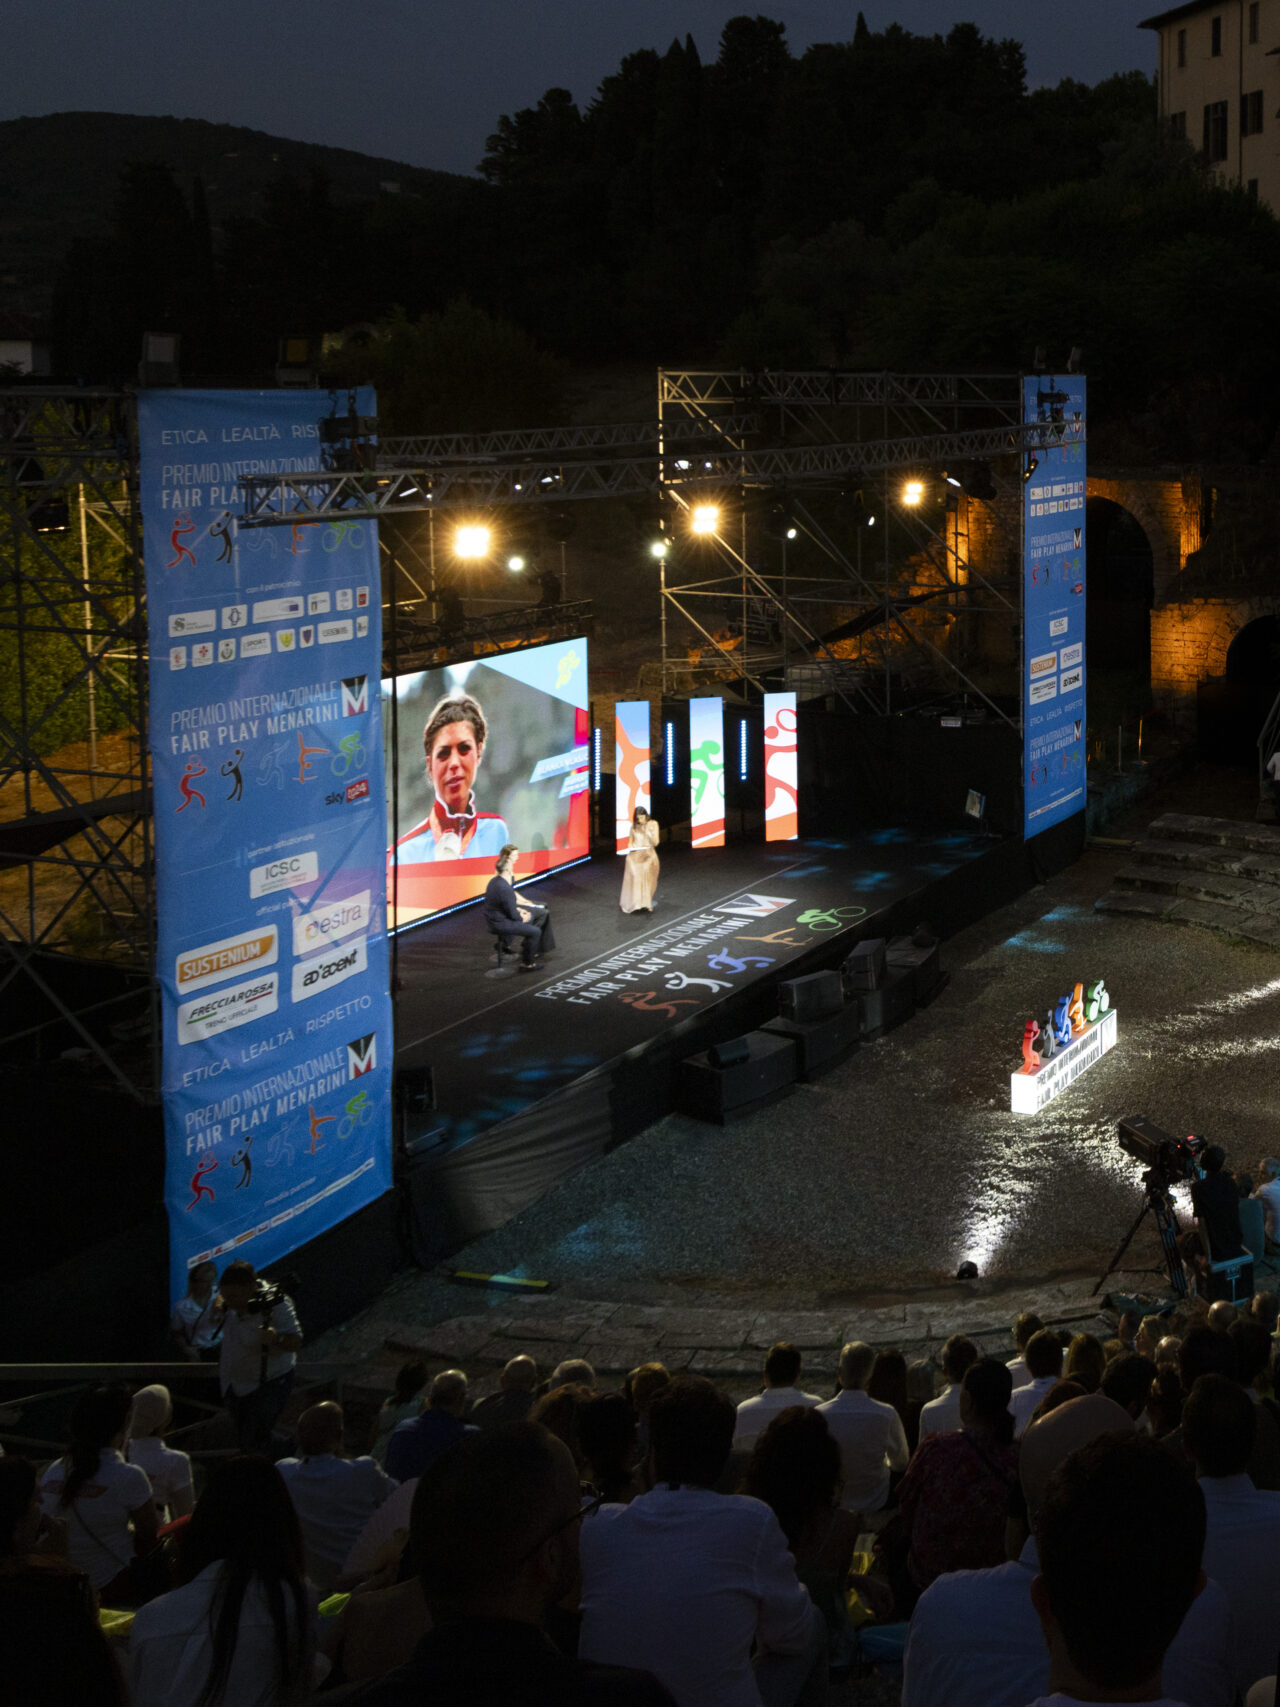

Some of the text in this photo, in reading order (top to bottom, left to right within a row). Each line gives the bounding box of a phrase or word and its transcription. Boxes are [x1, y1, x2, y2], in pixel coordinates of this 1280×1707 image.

[161, 429, 208, 445] ETICA
[222, 424, 281, 443] LEALTÀ
[161, 462, 220, 486] PREMIO
[161, 488, 202, 509] FAIR
[170, 680, 338, 733] PREMIO INTERNAZIONALE
[171, 703, 339, 755] FAIR PLAY MENARINI
[265, 858, 300, 880] ICSC
[320, 904, 361, 934] estra
[183, 940, 261, 981] SUSTENIUM
[534, 912, 725, 1000] PREMIO INTERNAZIONALE
[566, 917, 755, 1005] FAIR PLAY MENARINI
[189, 981, 274, 1019] FRECCIAROSSA
[182, 995, 372, 1088] ETICA LEALTÀ RISPETTO
[184, 1046, 345, 1135] PREMIO INTERNAZIONALE
[1053, 1071, 1069, 1096] PLAY
[186, 1069, 347, 1156] FAIR PLAY MENARINI
